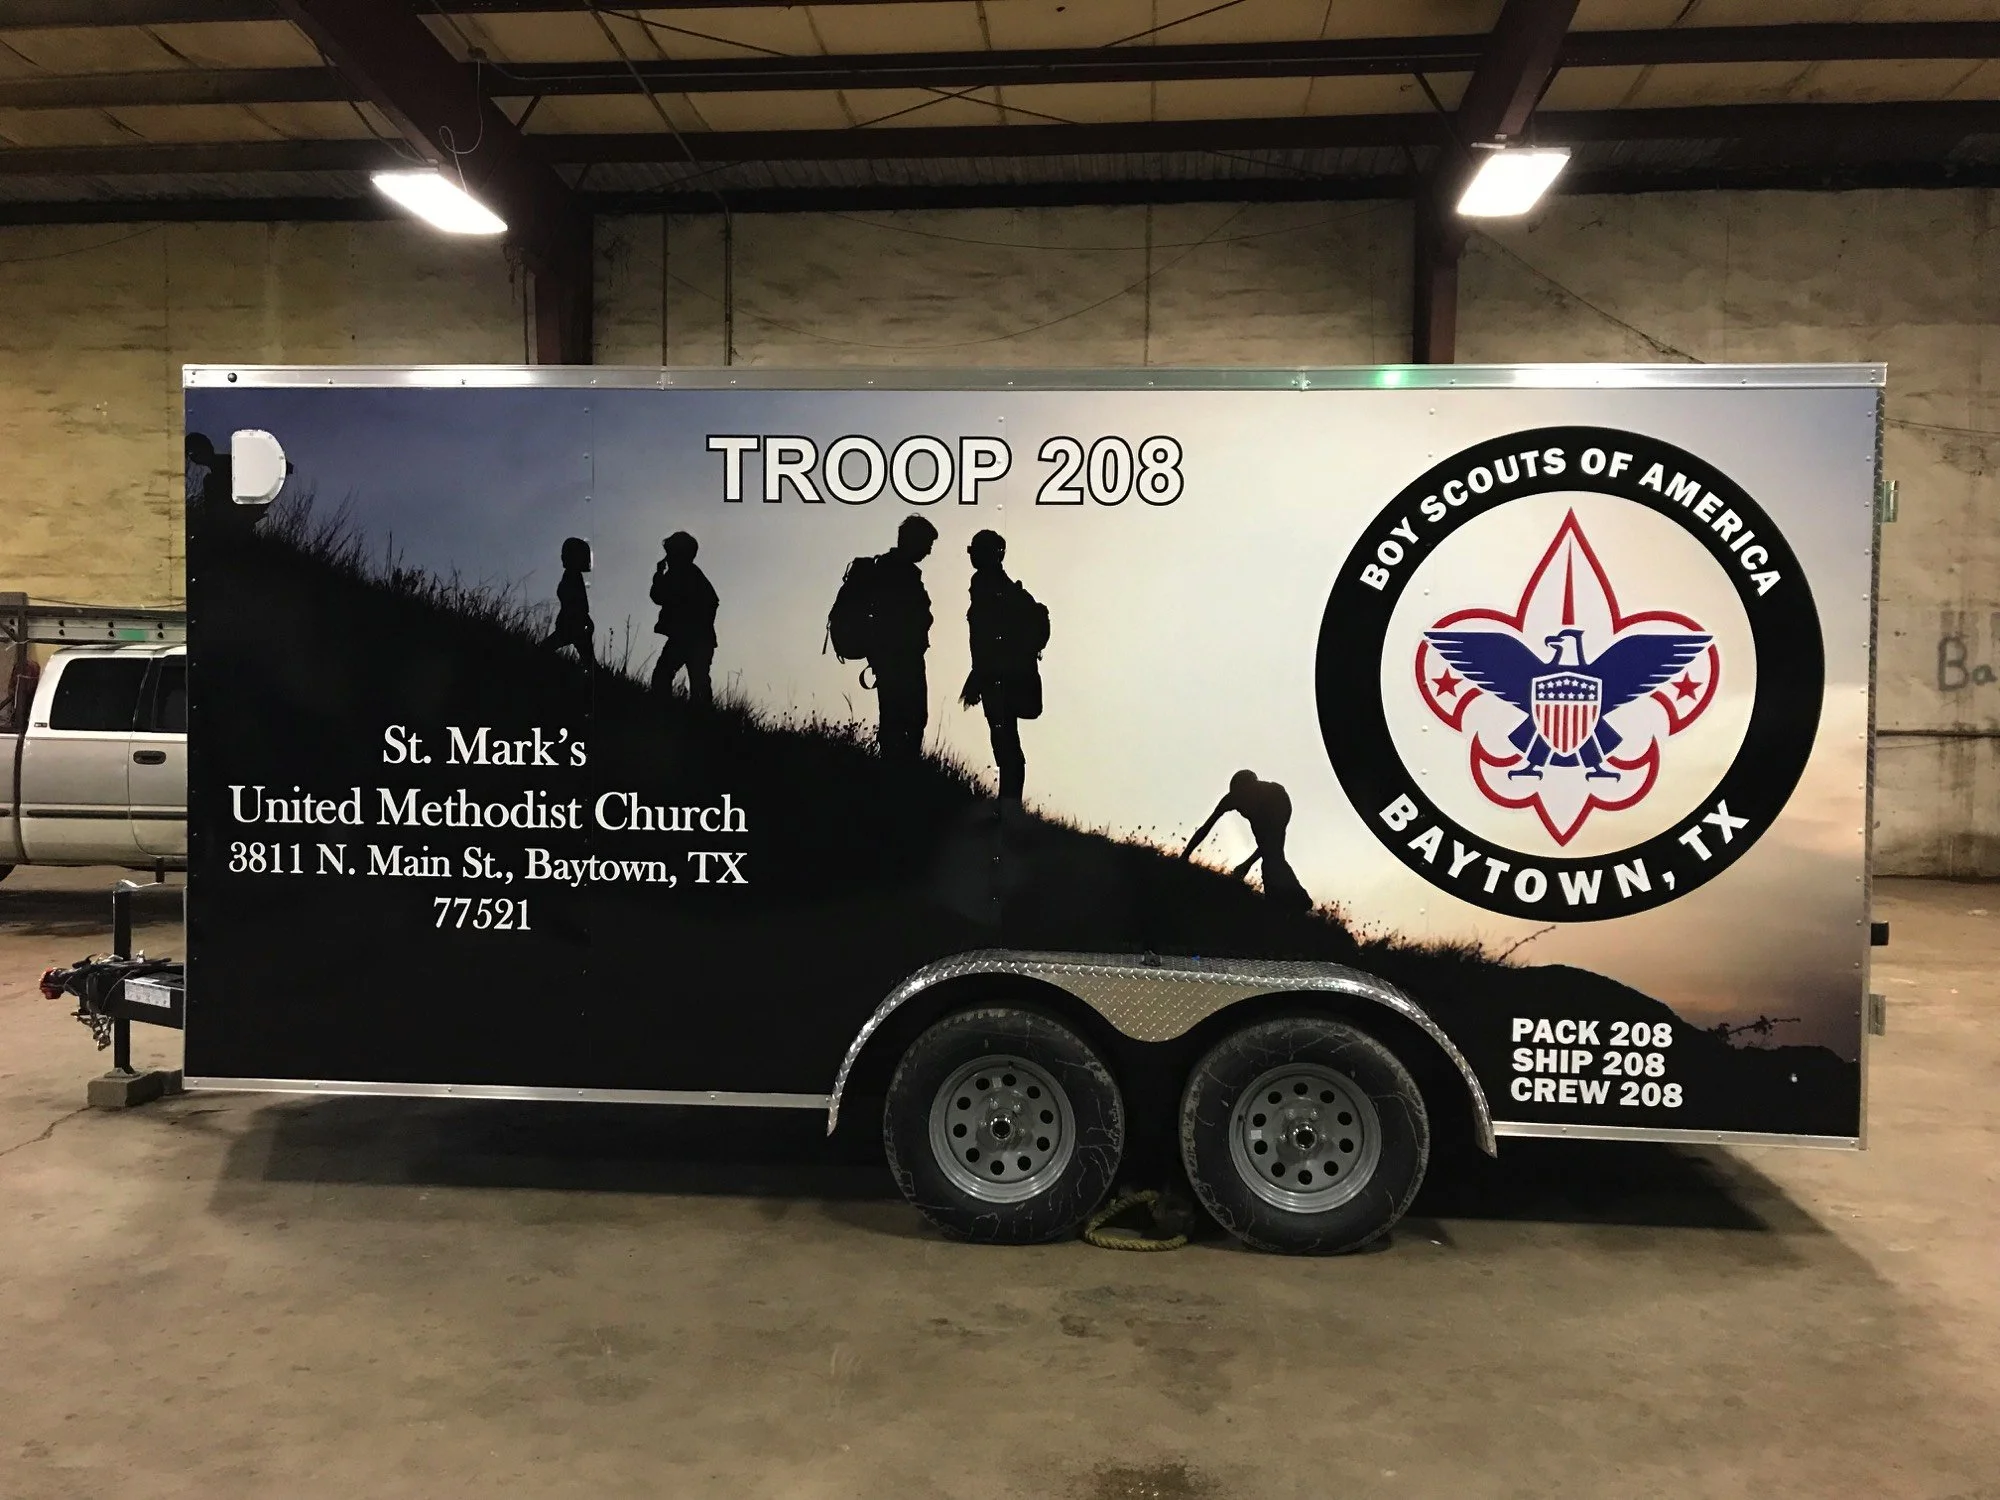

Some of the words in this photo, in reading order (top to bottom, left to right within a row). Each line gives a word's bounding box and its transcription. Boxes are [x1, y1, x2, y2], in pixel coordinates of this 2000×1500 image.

[706, 434, 1012, 505] TROOP
[1036, 436, 1184, 506] 208
[1360, 520, 1420, 591] BOY
[1421, 447, 1567, 523] SCOUTS
[1580, 447, 1633, 478] OF
[1639, 463, 1782, 597] AMERICA
[383, 724, 432, 764] St.
[446, 726, 587, 767] Mark’s
[228, 785, 365, 826] United
[376, 787, 583, 830] Methodist
[594, 791, 749, 833] Church
[228, 841, 304, 874] 3811
[316, 843, 356, 876] N.
[366, 844, 452, 878] Main
[462, 846, 514, 885] St.,
[524, 847, 677, 889] Baytown,
[688, 851, 749, 884] TX
[1379, 793, 1676, 906] BAYTOWN,
[1680, 799, 1750, 863] TX
[433, 896, 532, 931] 77521
[1512, 1018, 1601, 1046] PACK
[1609, 1021, 1673, 1048] 208
[1512, 1048, 1594, 1074] SHIP
[1602, 1051, 1666, 1077] 208
[1510, 1077, 1611, 1105] CREW
[1619, 1082, 1683, 1108] 208
